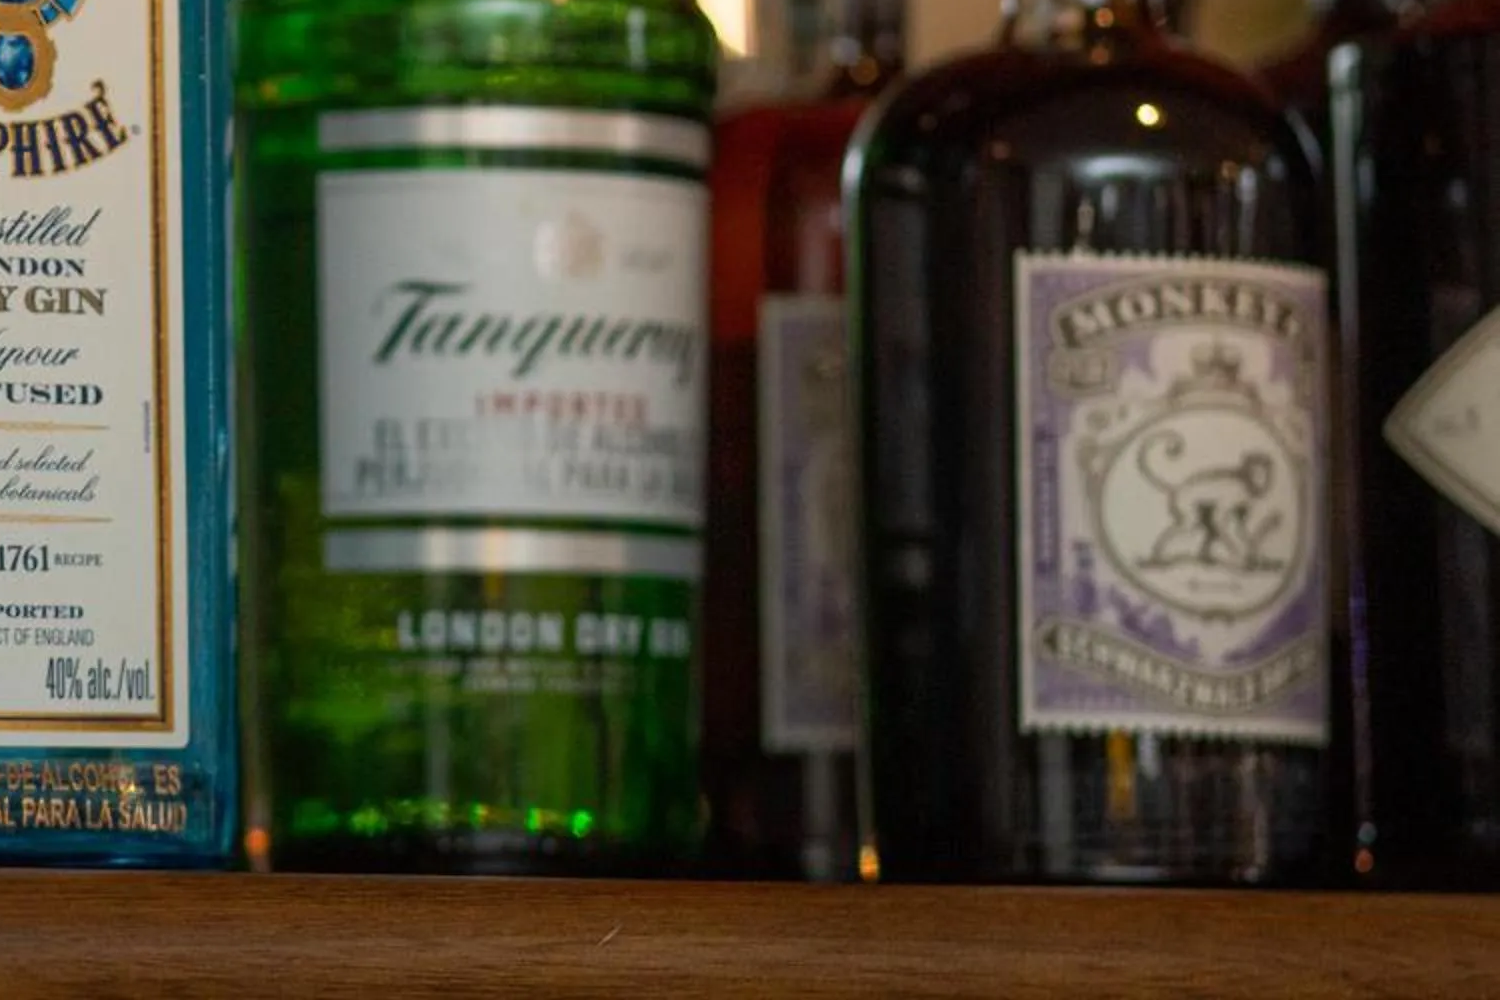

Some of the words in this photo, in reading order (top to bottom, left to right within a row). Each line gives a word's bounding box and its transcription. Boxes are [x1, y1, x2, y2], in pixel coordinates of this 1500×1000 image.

[24, 285, 107, 317] GIN
[15, 444, 95, 471] selected
[54, 553, 104, 568] RECIPE
[13, 628, 32, 646] OF
[34, 628, 96, 647] ENGLAND
[45, 657, 83, 701] 40%
[5, 761, 37, 792] DE
[153, 763, 183, 796] ES
[21, 797, 82, 829] PARA
[85, 799, 113, 829] LA
[118, 799, 188, 832] SALUD
